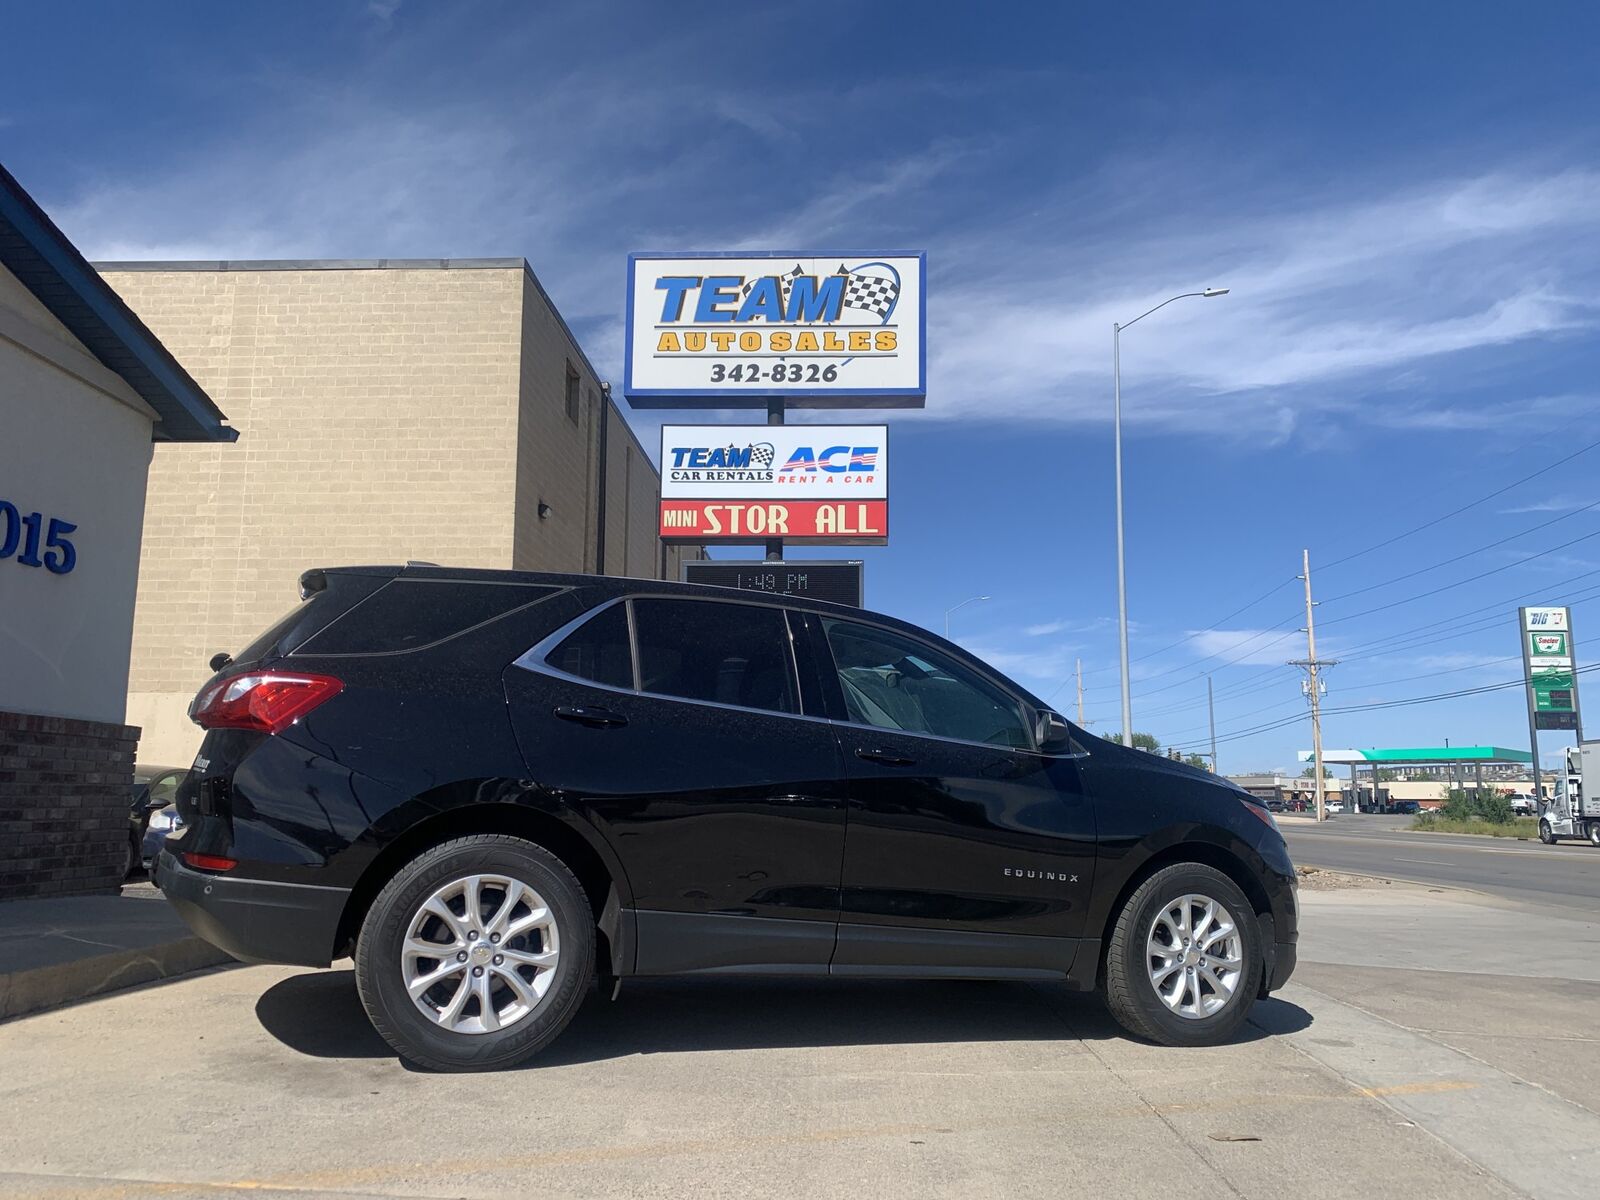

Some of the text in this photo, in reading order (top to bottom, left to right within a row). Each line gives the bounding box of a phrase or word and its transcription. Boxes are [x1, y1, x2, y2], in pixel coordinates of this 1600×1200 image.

[654, 275, 849, 323] TEAM
[657, 331, 898, 352] AUTO SALES
[710, 363, 838, 383] 342-8326
[670, 447, 752, 468] TEAM
[779, 446, 879, 473] ACE
[671, 471, 774, 481] CAR RENTALS
[778, 476, 875, 484] RENT A CAR
[663, 504, 879, 534] MINI STOR ALL
[737, 573, 808, 590] 1:49 PM
[1530, 612, 1549, 625] BIG
[1004, 868, 1079, 882] EQUINOX
